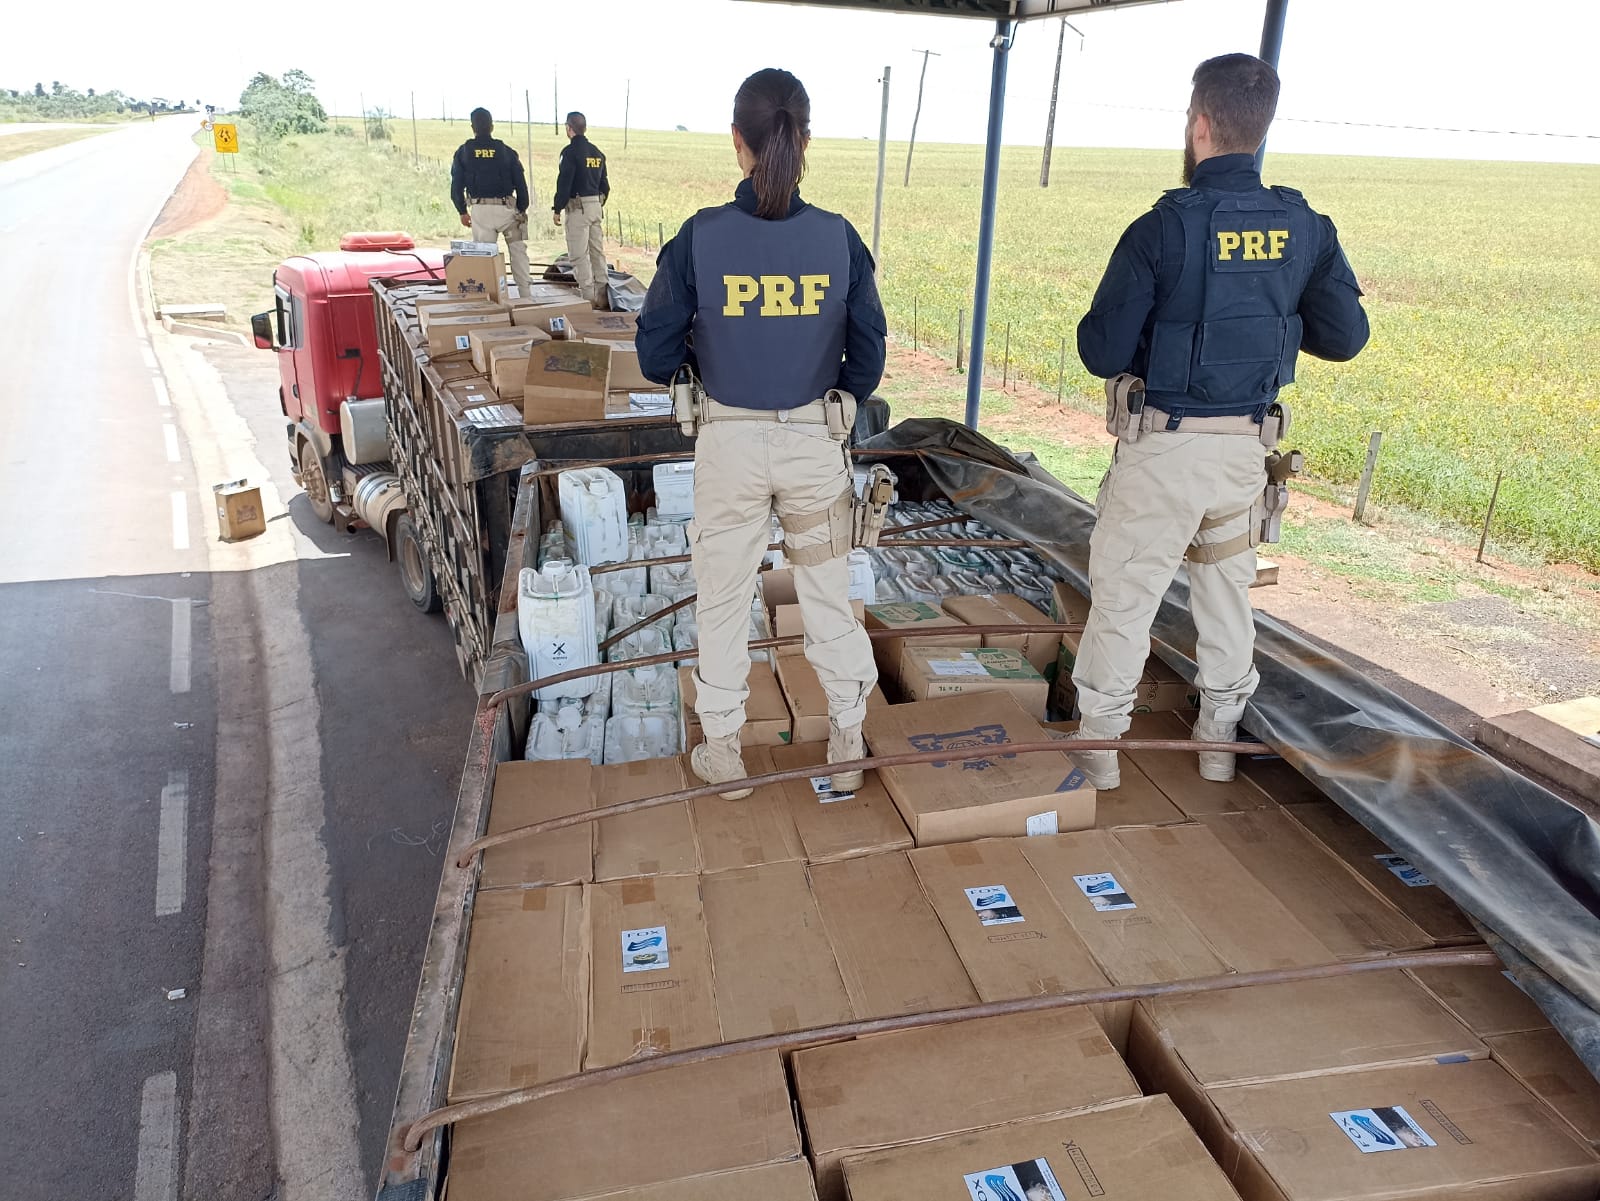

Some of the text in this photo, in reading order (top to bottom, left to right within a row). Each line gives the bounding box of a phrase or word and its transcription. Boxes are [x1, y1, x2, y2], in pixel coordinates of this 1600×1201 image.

[474, 149, 495, 158] PRF
[586, 157, 601, 168] PRF
[1217, 230, 1289, 261] PRF
[723, 274, 830, 317] PRF
[970, 887, 1001, 895] FOX
[627, 930, 659, 938] FOX
[1341, 1117, 1370, 1148] FOX
[972, 1178, 989, 1201] OX
